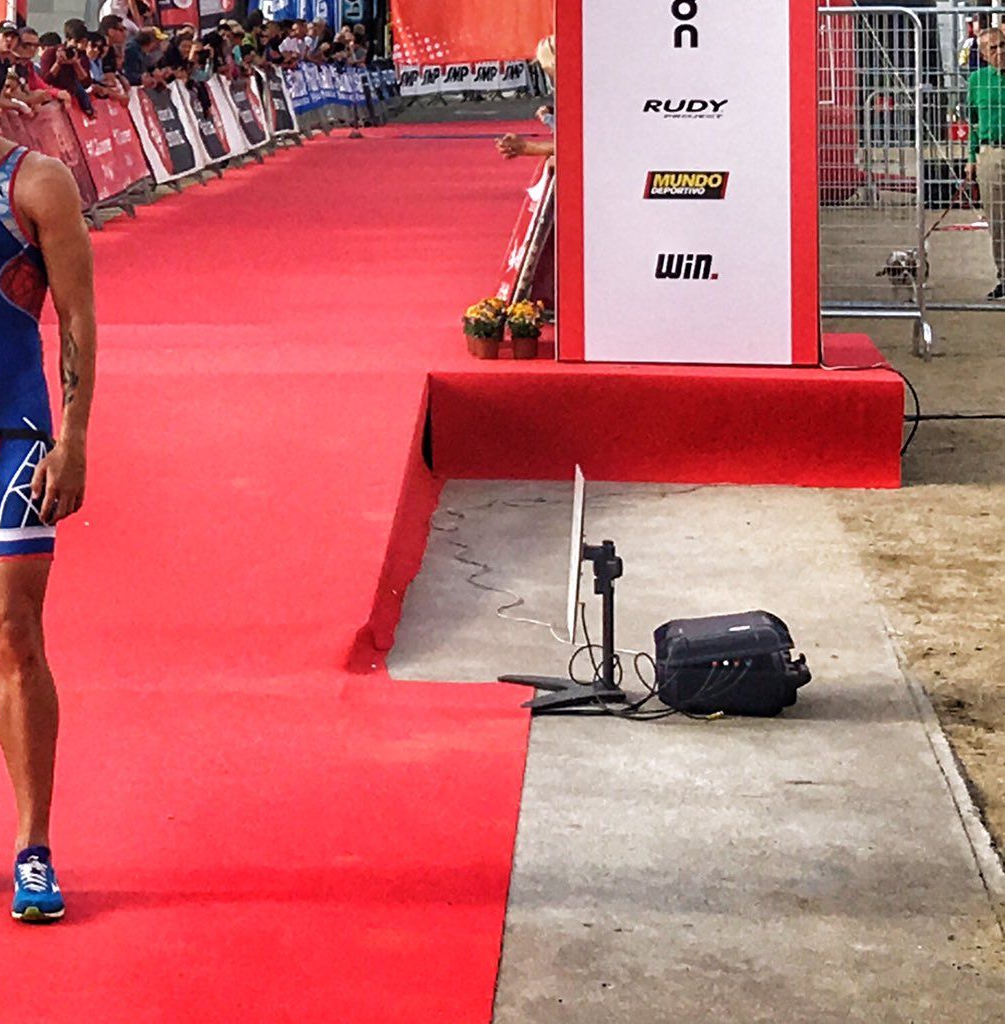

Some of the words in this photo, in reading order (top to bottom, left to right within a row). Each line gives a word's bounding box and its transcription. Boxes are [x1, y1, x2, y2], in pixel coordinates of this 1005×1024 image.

[643, 99, 728, 112] RUDY
[653, 173, 722, 188] MUNDO
[651, 186, 705, 195] DEPORTIVO
